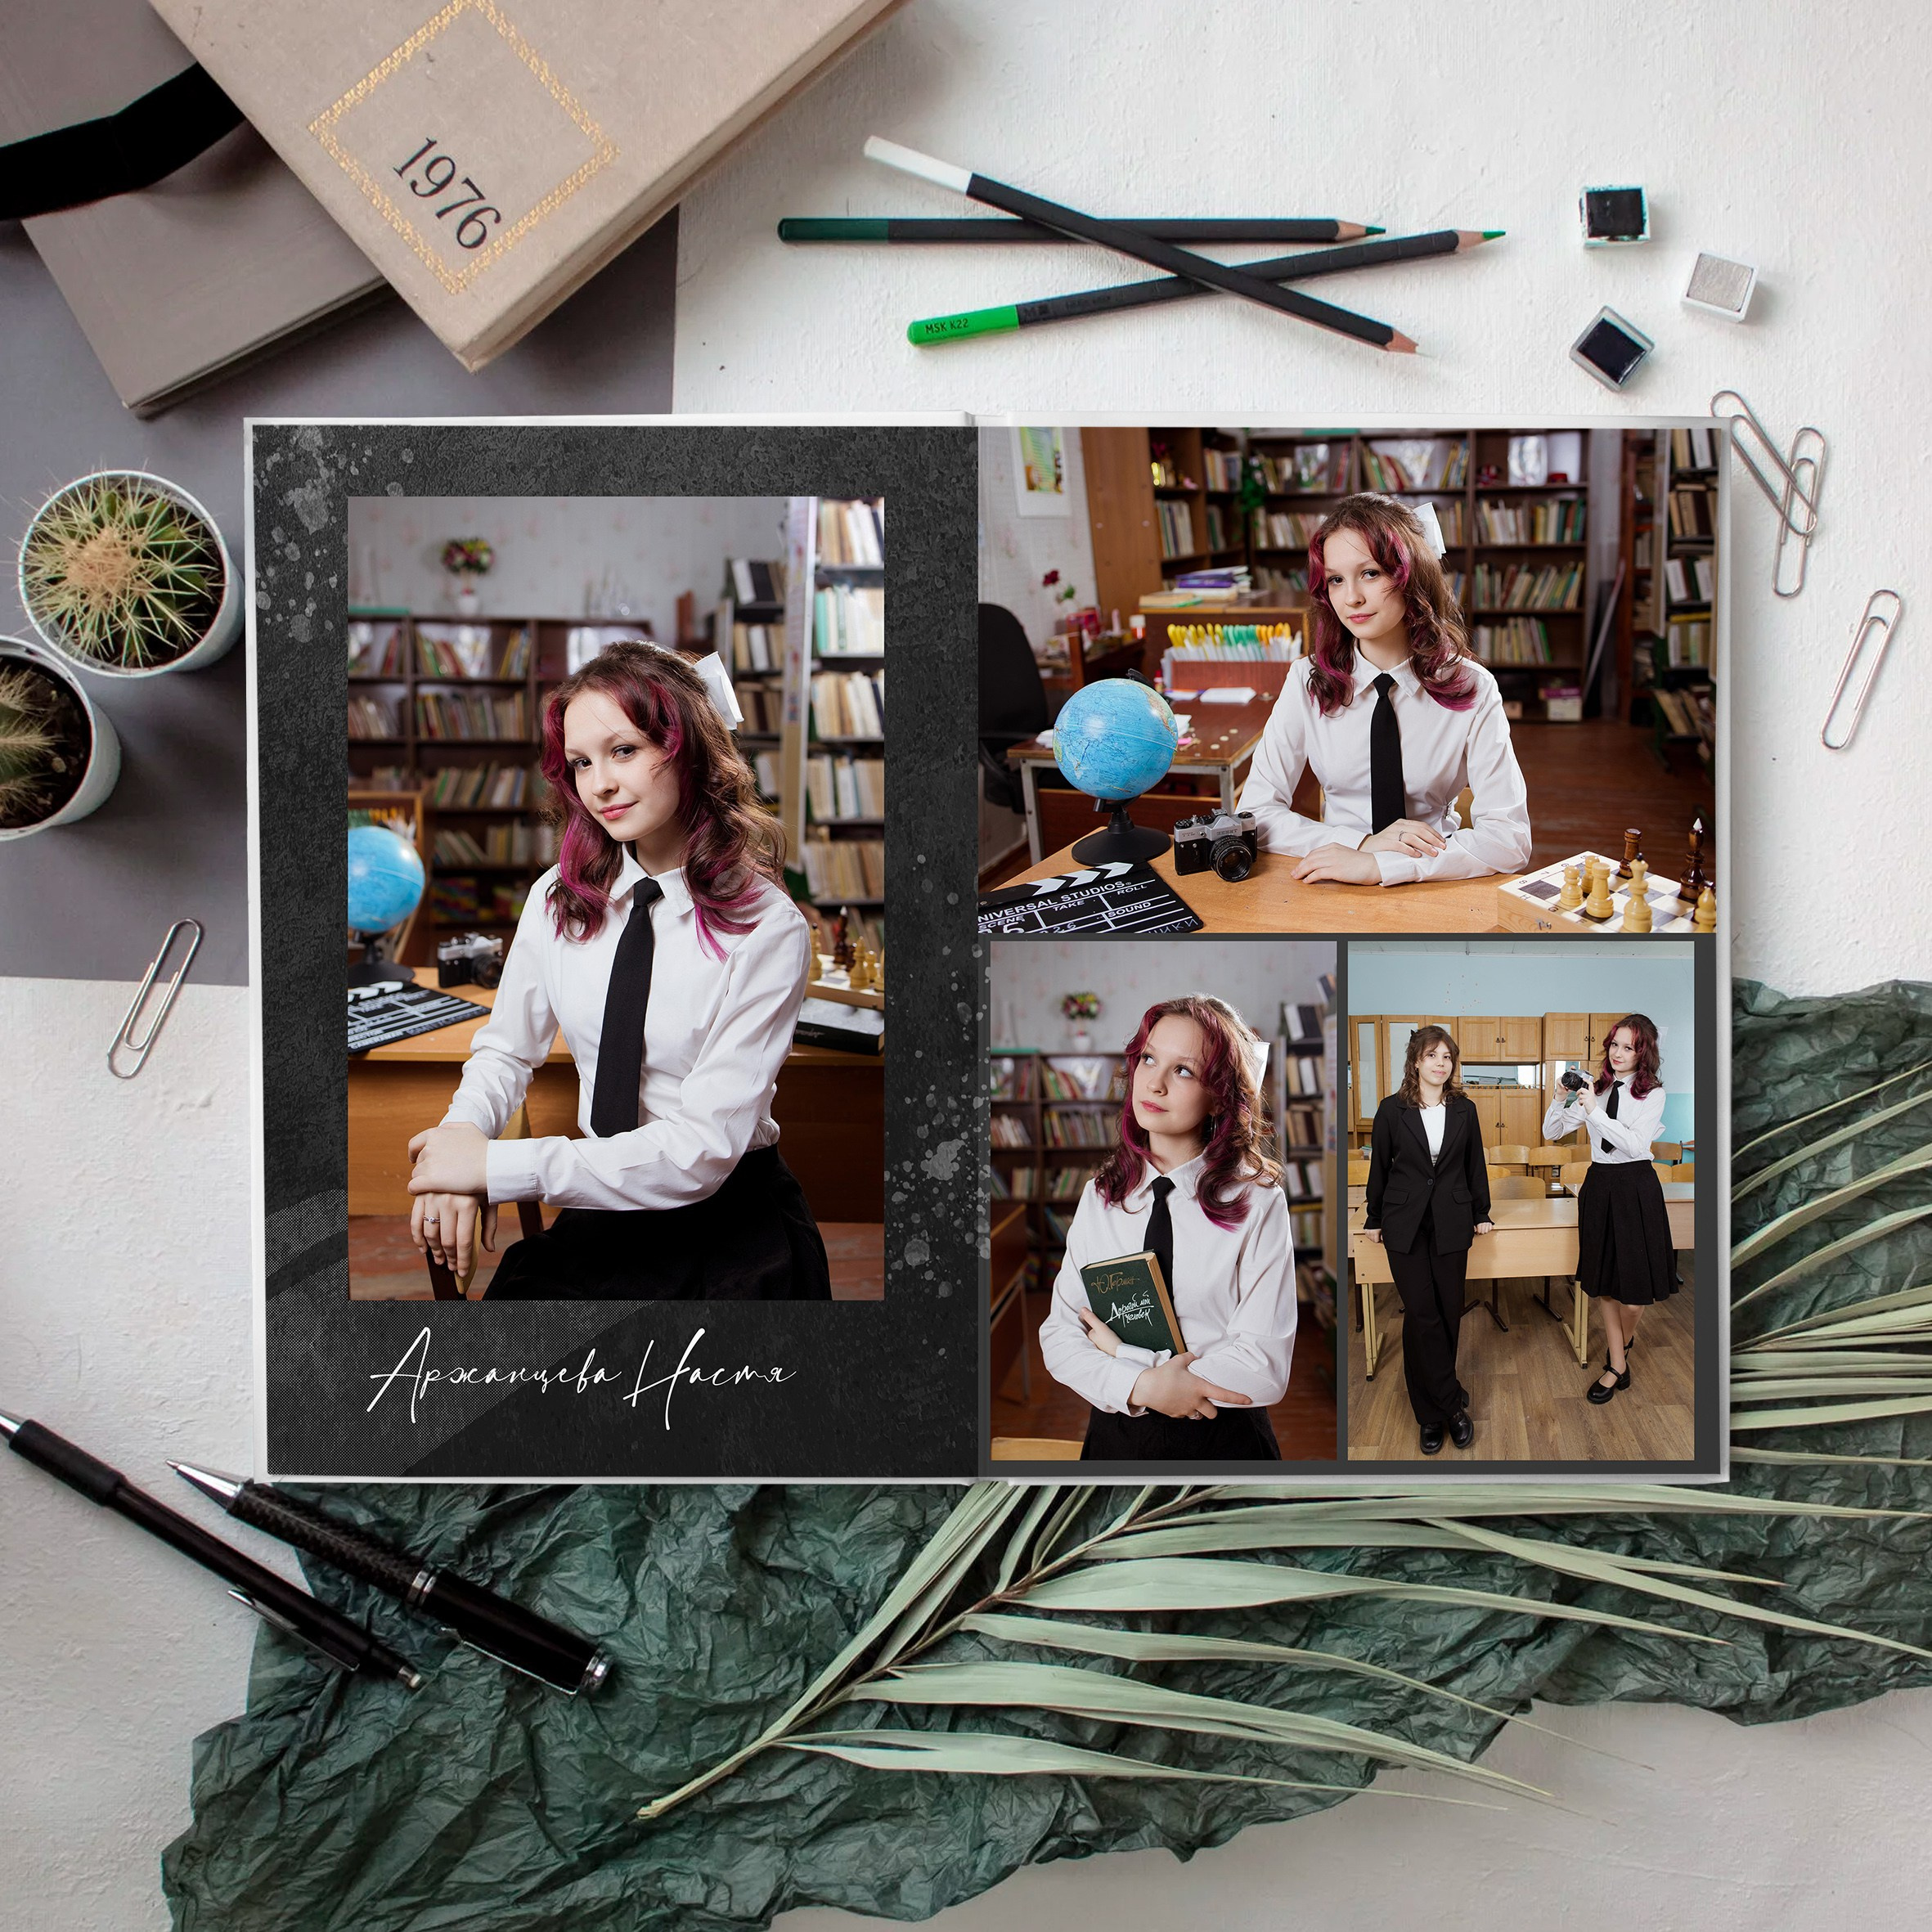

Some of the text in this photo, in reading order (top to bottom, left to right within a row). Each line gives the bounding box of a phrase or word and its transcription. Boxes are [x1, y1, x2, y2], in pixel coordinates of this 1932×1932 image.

[393, 137, 501, 249] 1976
[925, 318, 968, 334] MSK K22
[1053, 899, 1085, 911] TAKE
[1117, 884, 1148, 896] ROLL
[1108, 901, 1152, 917] SOUND
[978, 899, 1058, 923] NIVERSAL
[366, 1327, 798, 1431] Аржанцева Настя
